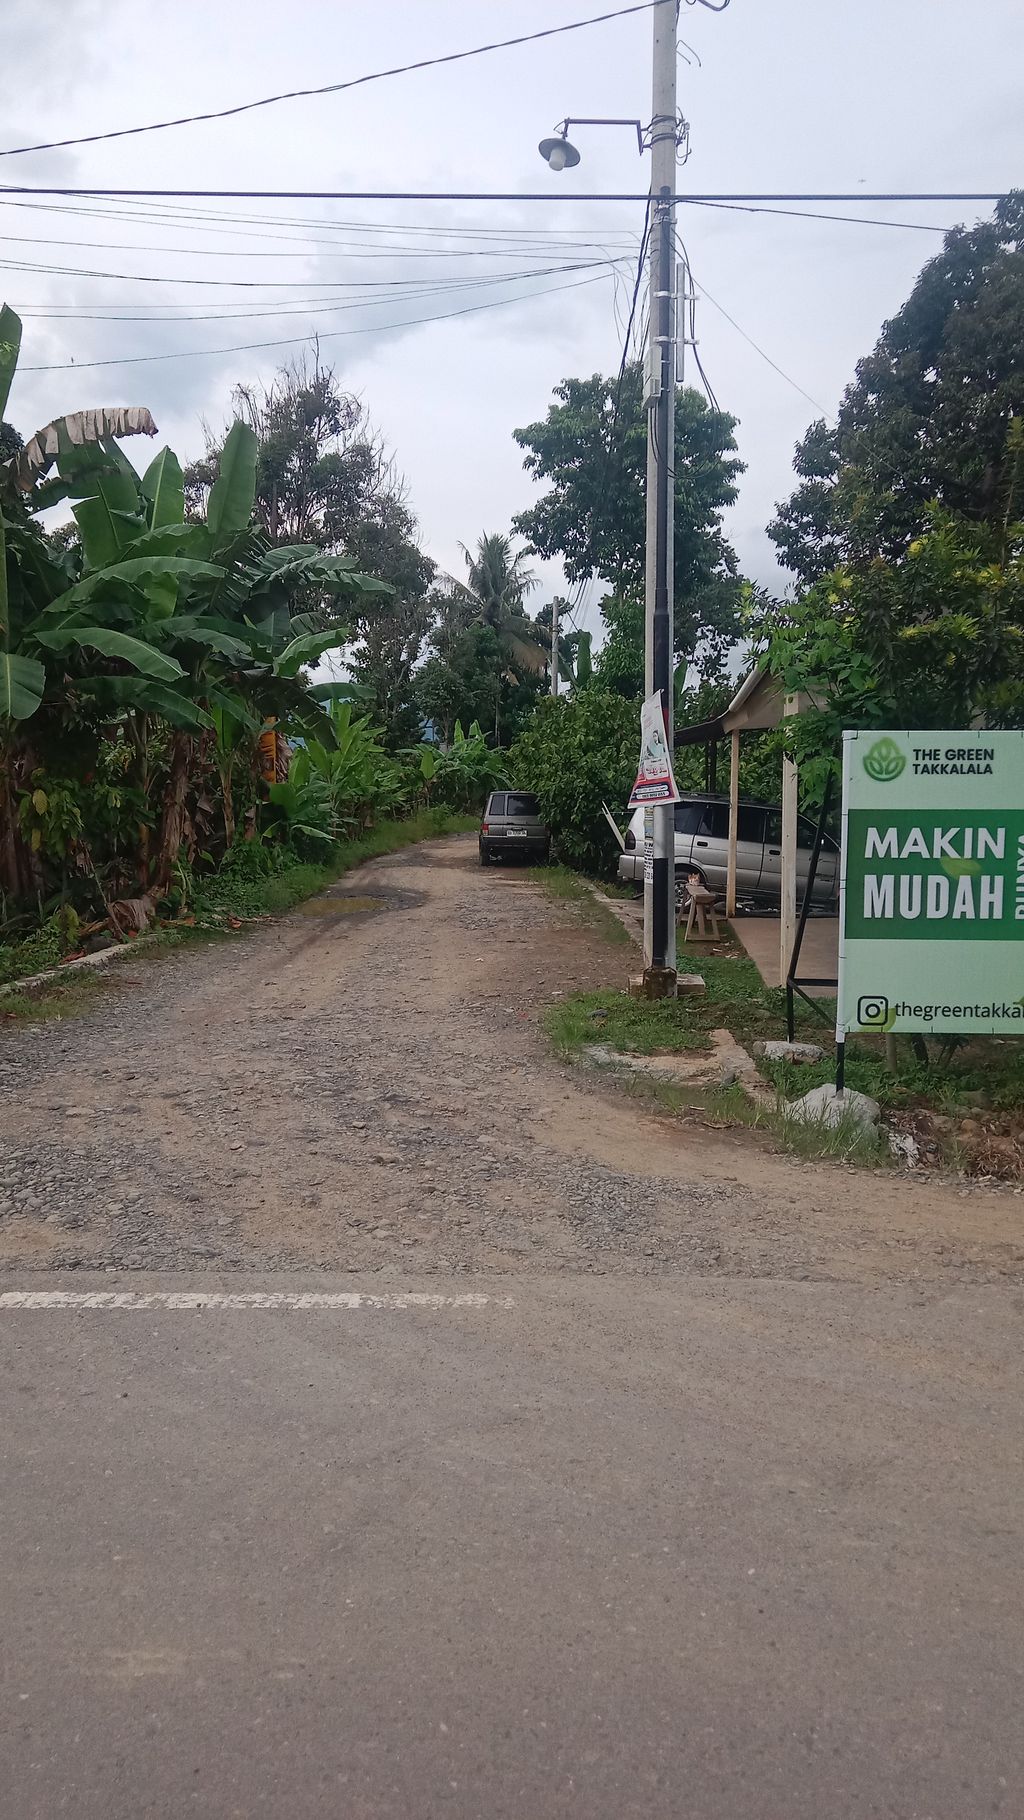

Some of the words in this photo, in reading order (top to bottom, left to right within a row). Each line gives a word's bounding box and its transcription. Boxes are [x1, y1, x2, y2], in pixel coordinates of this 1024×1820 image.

[913, 749, 941, 761] THE
[945, 749, 995, 761] GREEN
[912, 764, 993, 775] TAKKALALA
[864, 827, 1006, 859] MAKIN
[863, 874, 1004, 920] MUDAH
